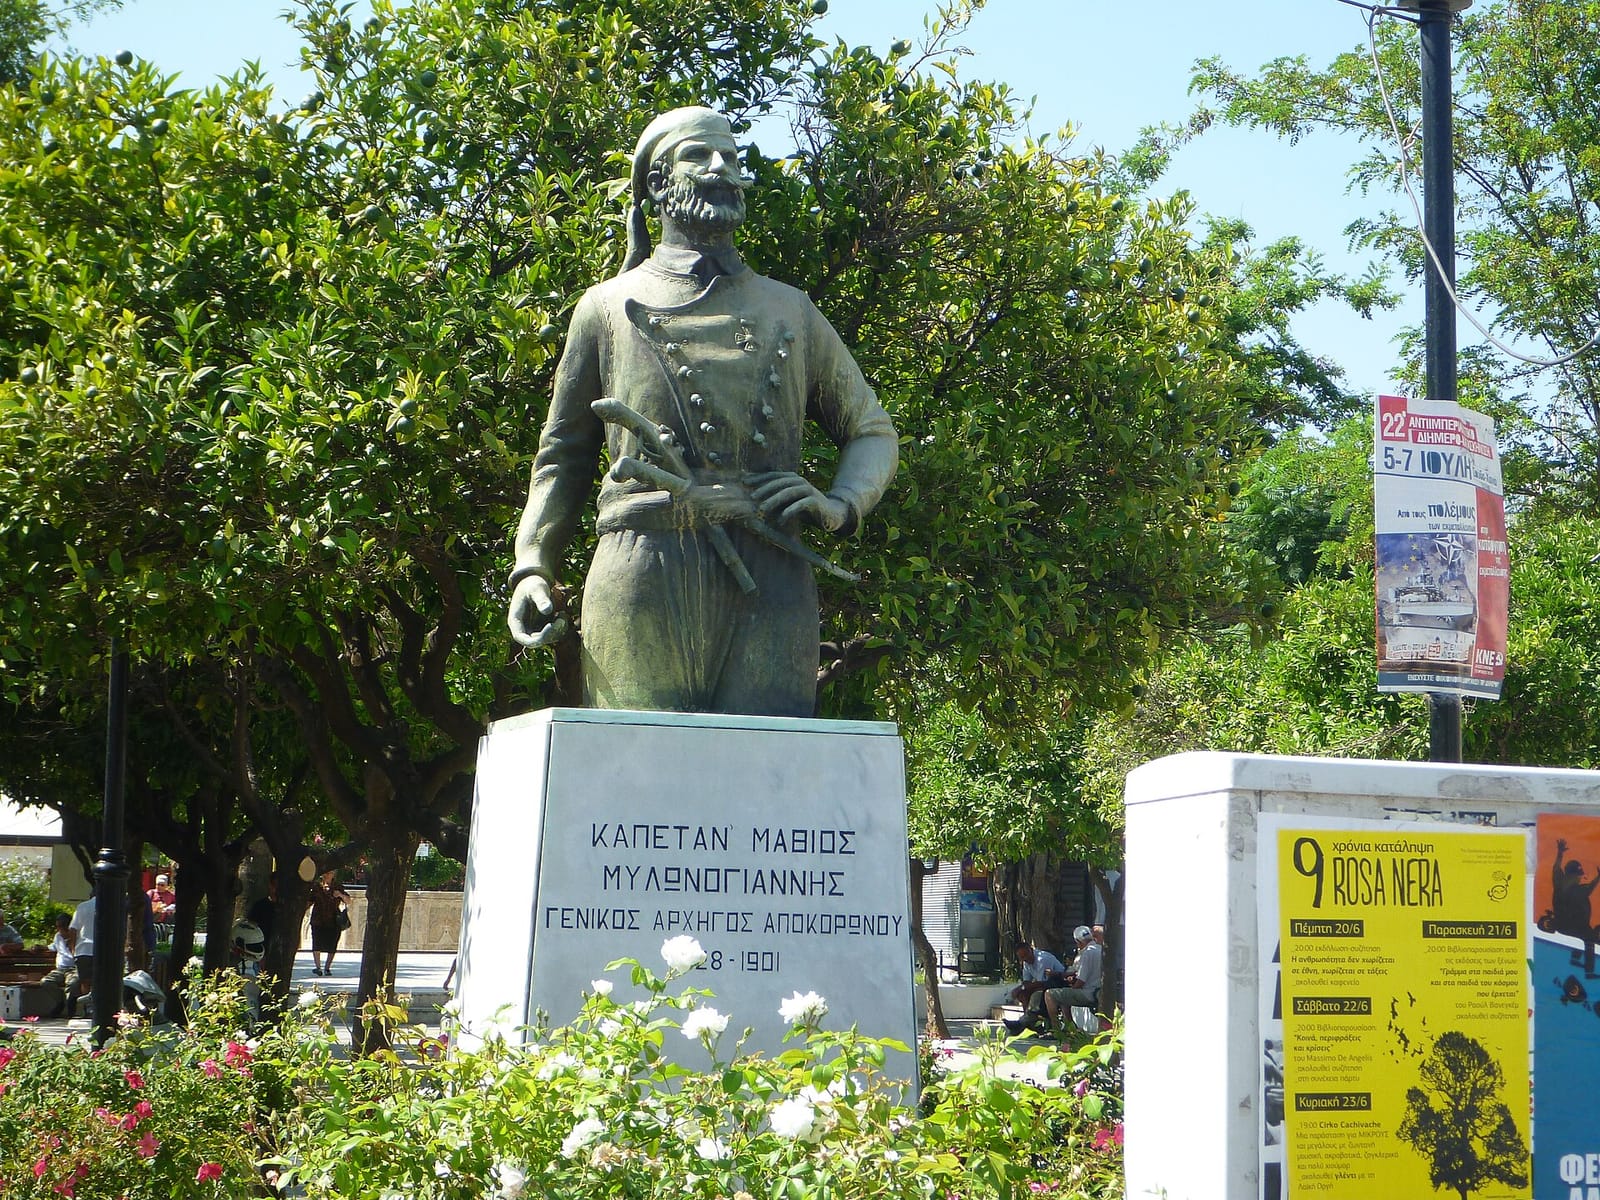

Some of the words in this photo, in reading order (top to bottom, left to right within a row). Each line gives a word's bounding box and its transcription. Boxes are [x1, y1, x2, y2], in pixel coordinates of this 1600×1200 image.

[1384, 446, 1412, 471] 5-7
[1421, 450, 1472, 480] ΙΟΥΛΗ
[1428, 501, 1475, 521] πολέμους
[752, 828, 856, 854] ΜΑΘΙΟΣ
[1332, 840, 1371, 854] χρόνια
[1375, 840, 1434, 855] κατάληψη
[603, 865, 844, 897] ΜΥΛΩΝΟΓΙΑΝΝΗΣ
[1293, 837, 1324, 908] 9
[1333, 857, 1386, 906] ROSA
[1393, 858, 1443, 907] NERA
[545, 907, 640, 930] ΓΕΝΙΚΟΣ
[652, 911, 753, 933] ΑΡΧΗΓΟΣ
[764, 912, 902, 936] ΑΠΟΚΟΡΩΝΟΥ
[1295, 923, 1332, 935] Πέμπτη
[1335, 923, 1360, 934] 20/6
[1429, 924, 1484, 936] Παρασκευή
[1488, 925, 1512, 935] 21/6
[741, 951, 780, 971] 1901
[1362, 956, 1394, 964] χωρίζεται
[1322, 967, 1355, 975] χωρίζεται
[1367, 967, 1388, 975] τάξεις
[1297, 1000, 1340, 1013] Σάββατο
[1343, 1001, 1368, 1011] 22/6
[1300, 1097, 1339, 1109] Κυριακή
[1343, 1097, 1367, 1107] 23/6
[1560, 1153, 1600, 1185] ΦΕ
